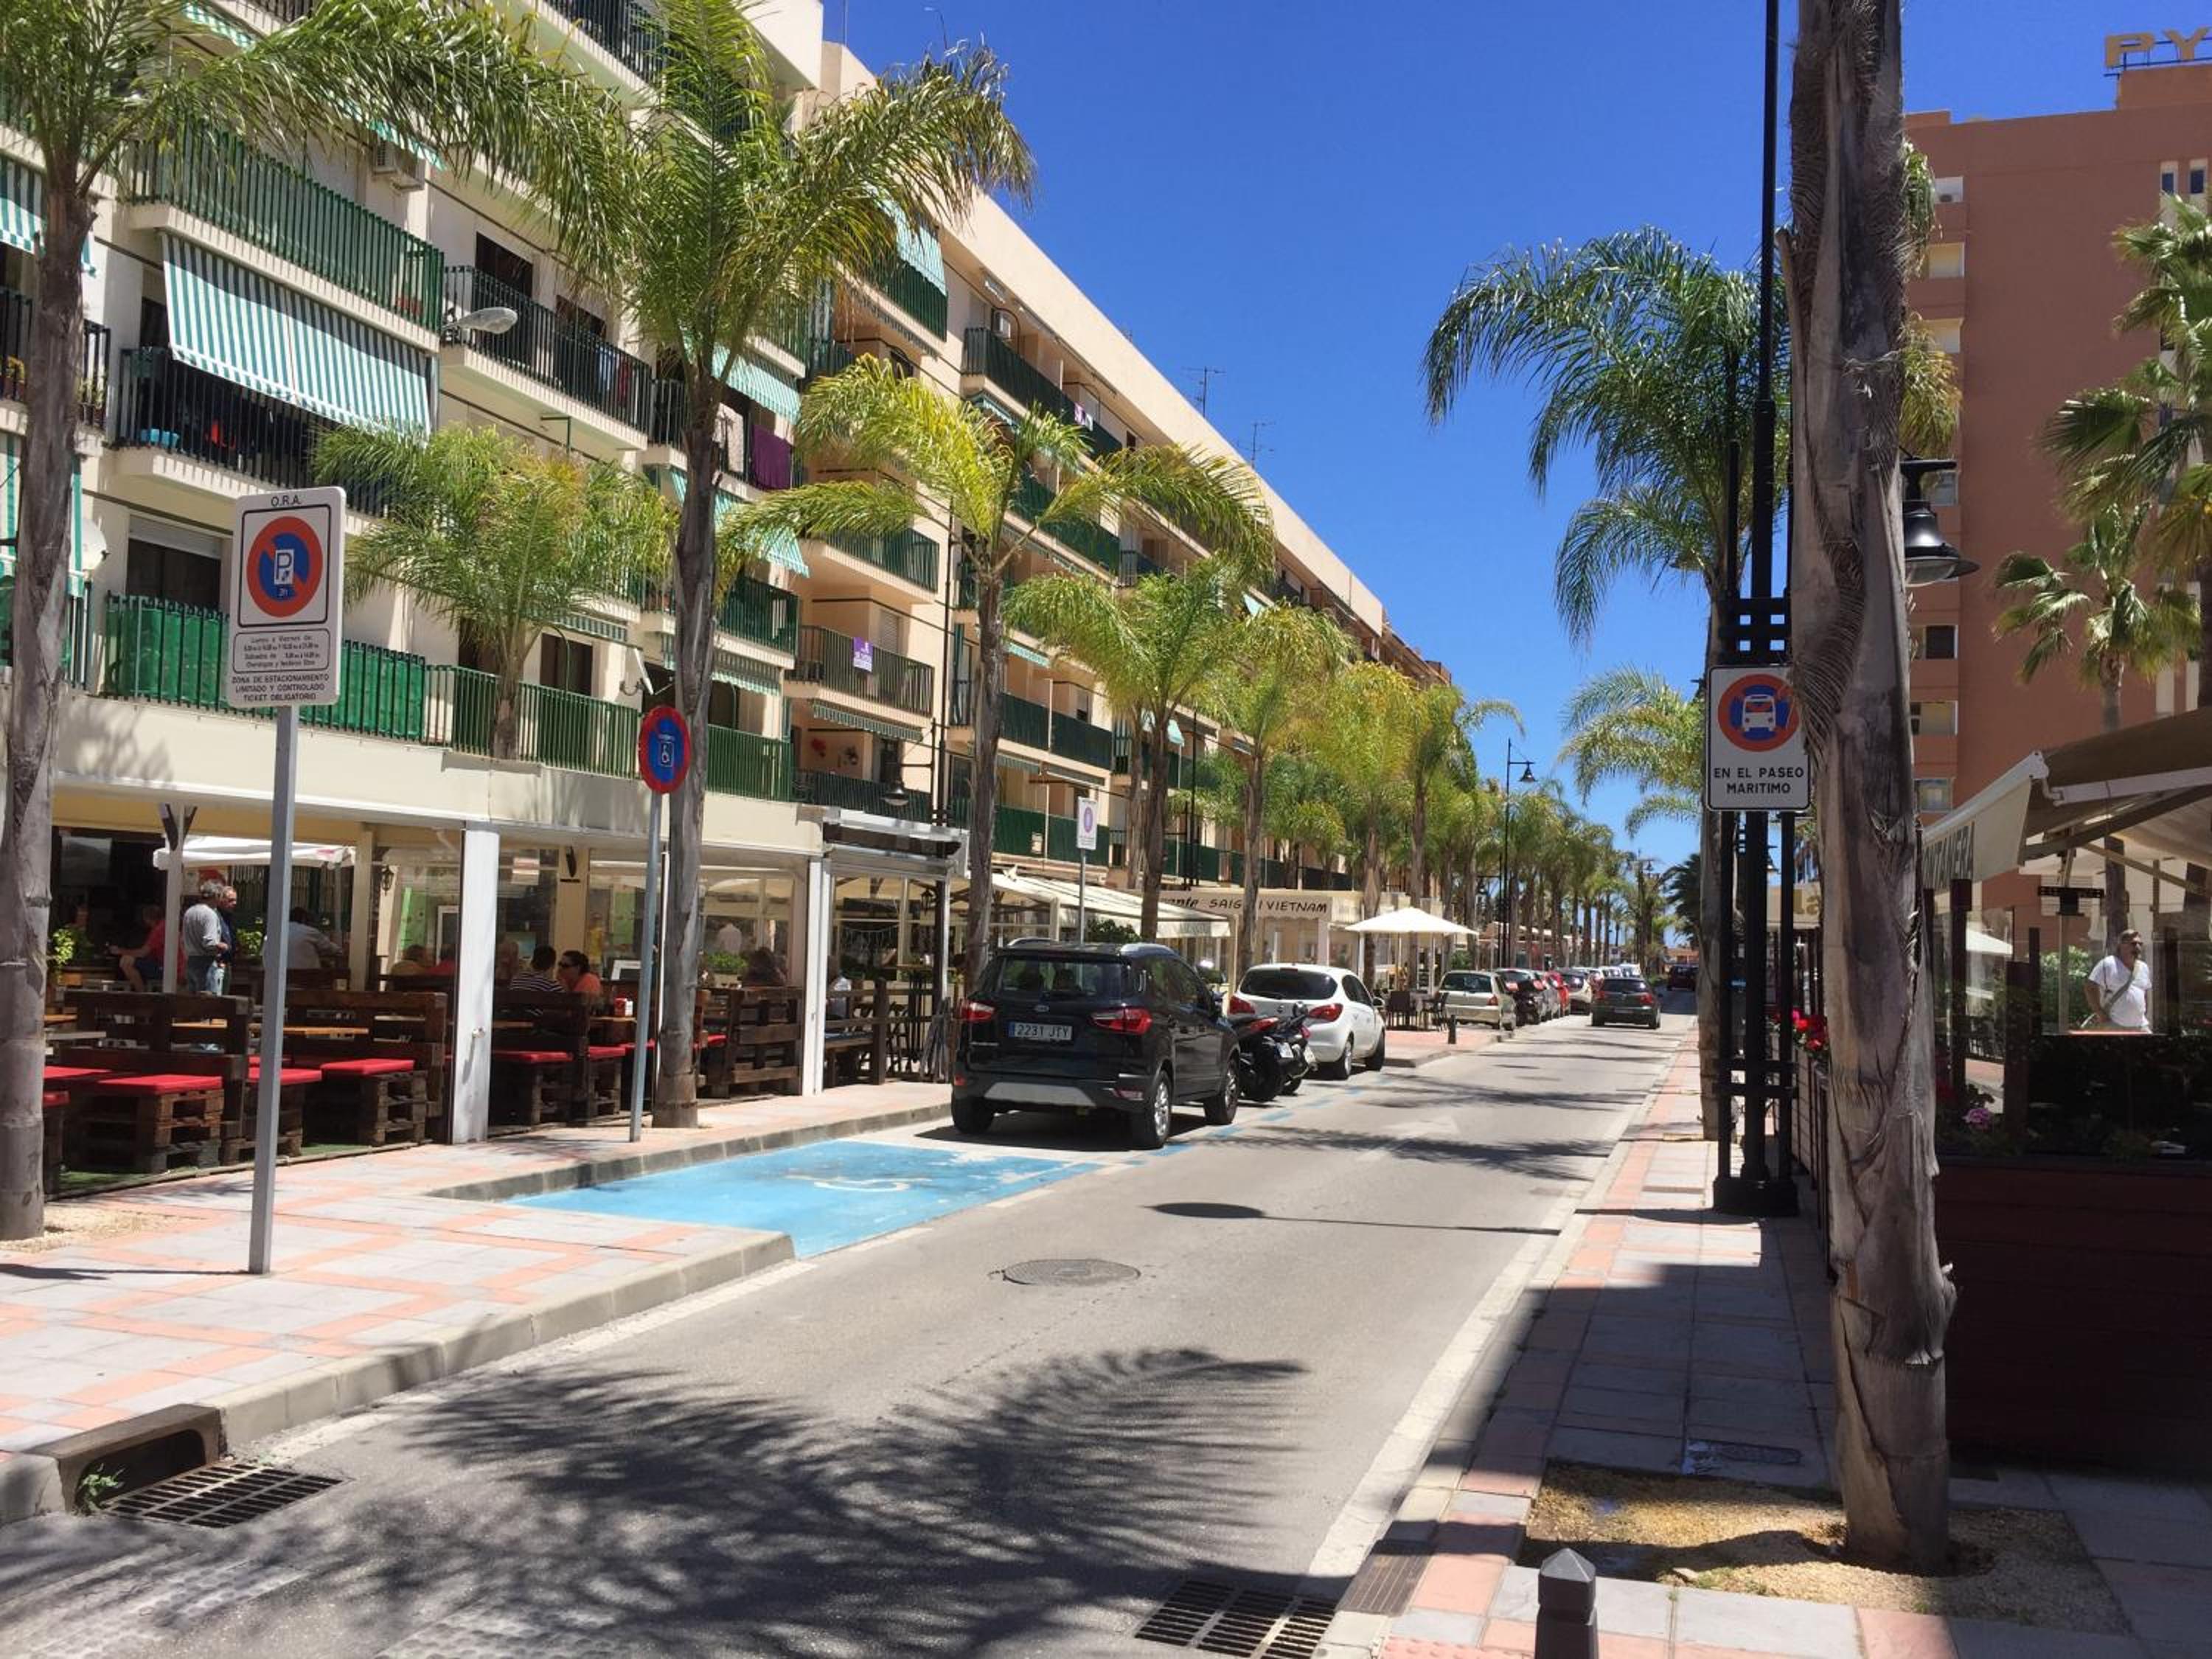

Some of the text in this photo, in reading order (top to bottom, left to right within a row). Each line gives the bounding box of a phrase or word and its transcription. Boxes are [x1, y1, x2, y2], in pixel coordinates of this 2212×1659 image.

[265, 673, 330, 683] ESTACIONAMIENTO
[235, 685, 267, 693] LIMITADO
[276, 684, 325, 692] CONTROLADO
[243, 692, 316, 702] TICKET OBLIGATORIO
[1714, 767, 1805, 778] EN EL PASEO
[1726, 783, 1792, 794] MARITIMO
[1265, 900, 1328, 914] VIETNAM
[1017, 1024, 1069, 1038] 2231 JTY
